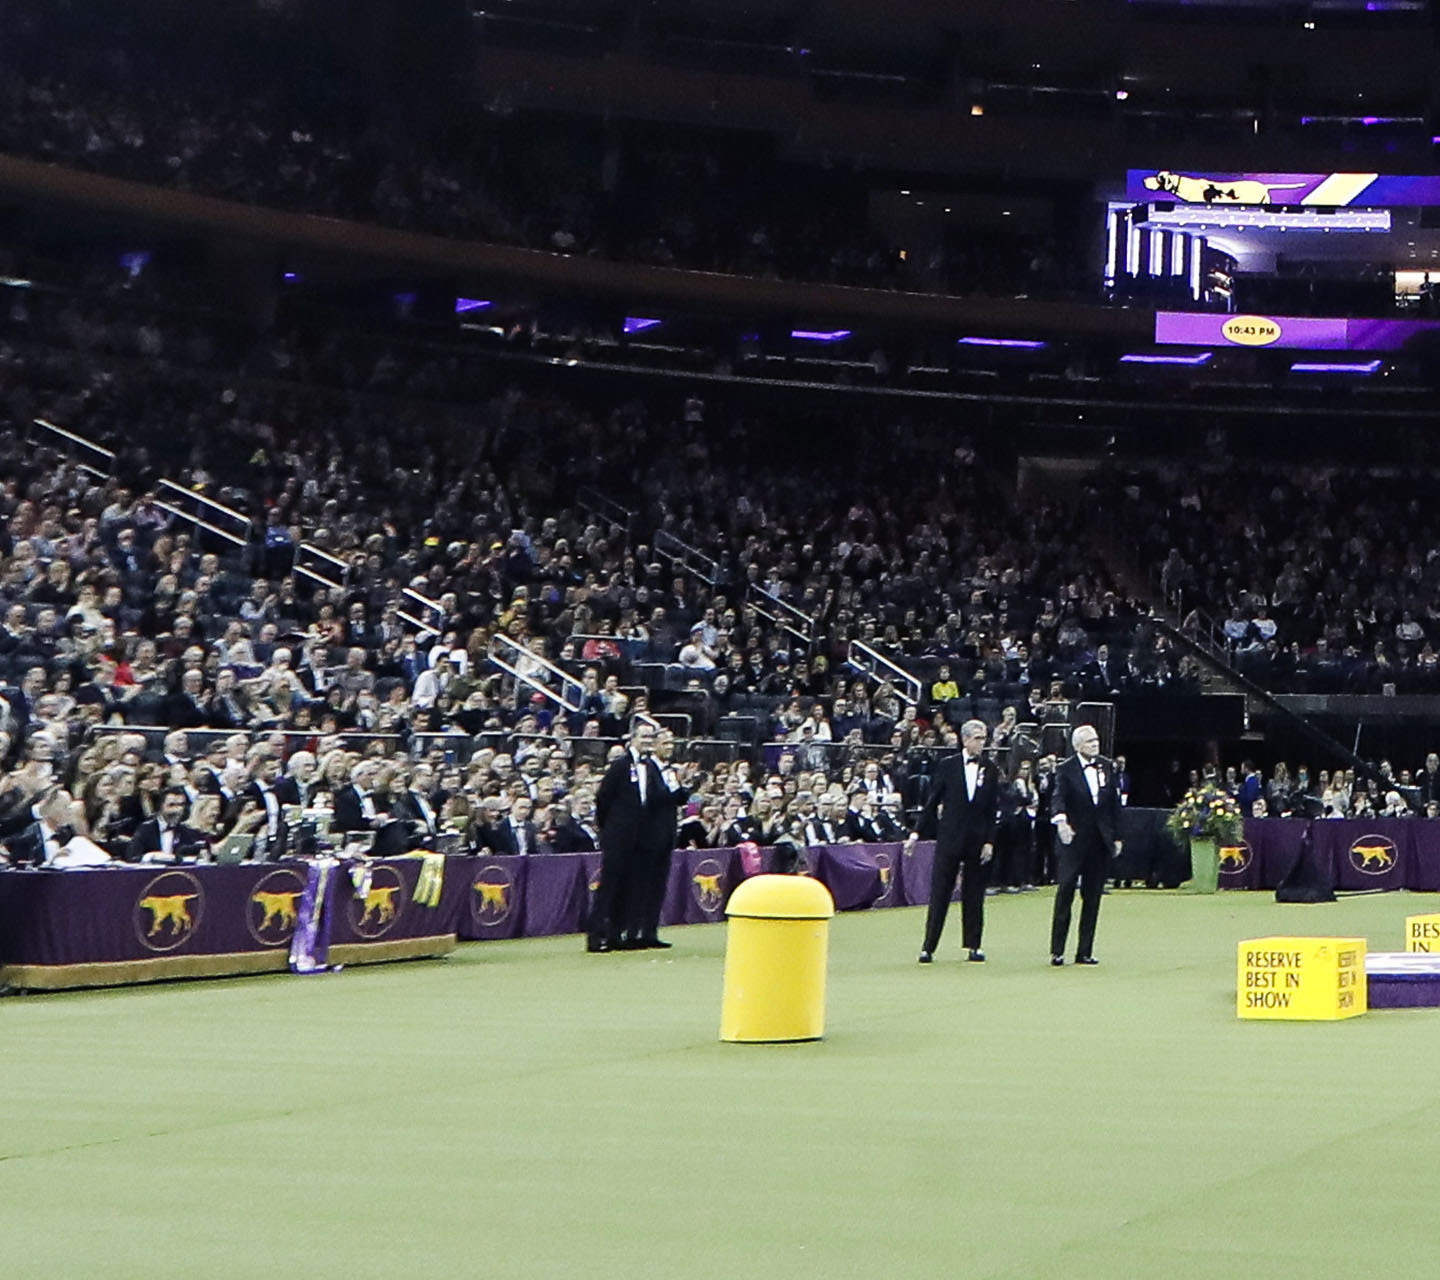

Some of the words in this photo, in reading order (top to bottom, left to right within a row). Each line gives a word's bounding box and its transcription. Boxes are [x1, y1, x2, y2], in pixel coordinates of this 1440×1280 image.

[1227, 325, 1257, 338] 10:43
[1259, 326, 1276, 337] PM
[1411, 941, 1432, 953] IN
[1246, 951, 1302, 969] RESERVE
[1245, 971, 1277, 989] BEST
[1285, 971, 1300, 989] IN
[1245, 991, 1293, 1009] SHOW
